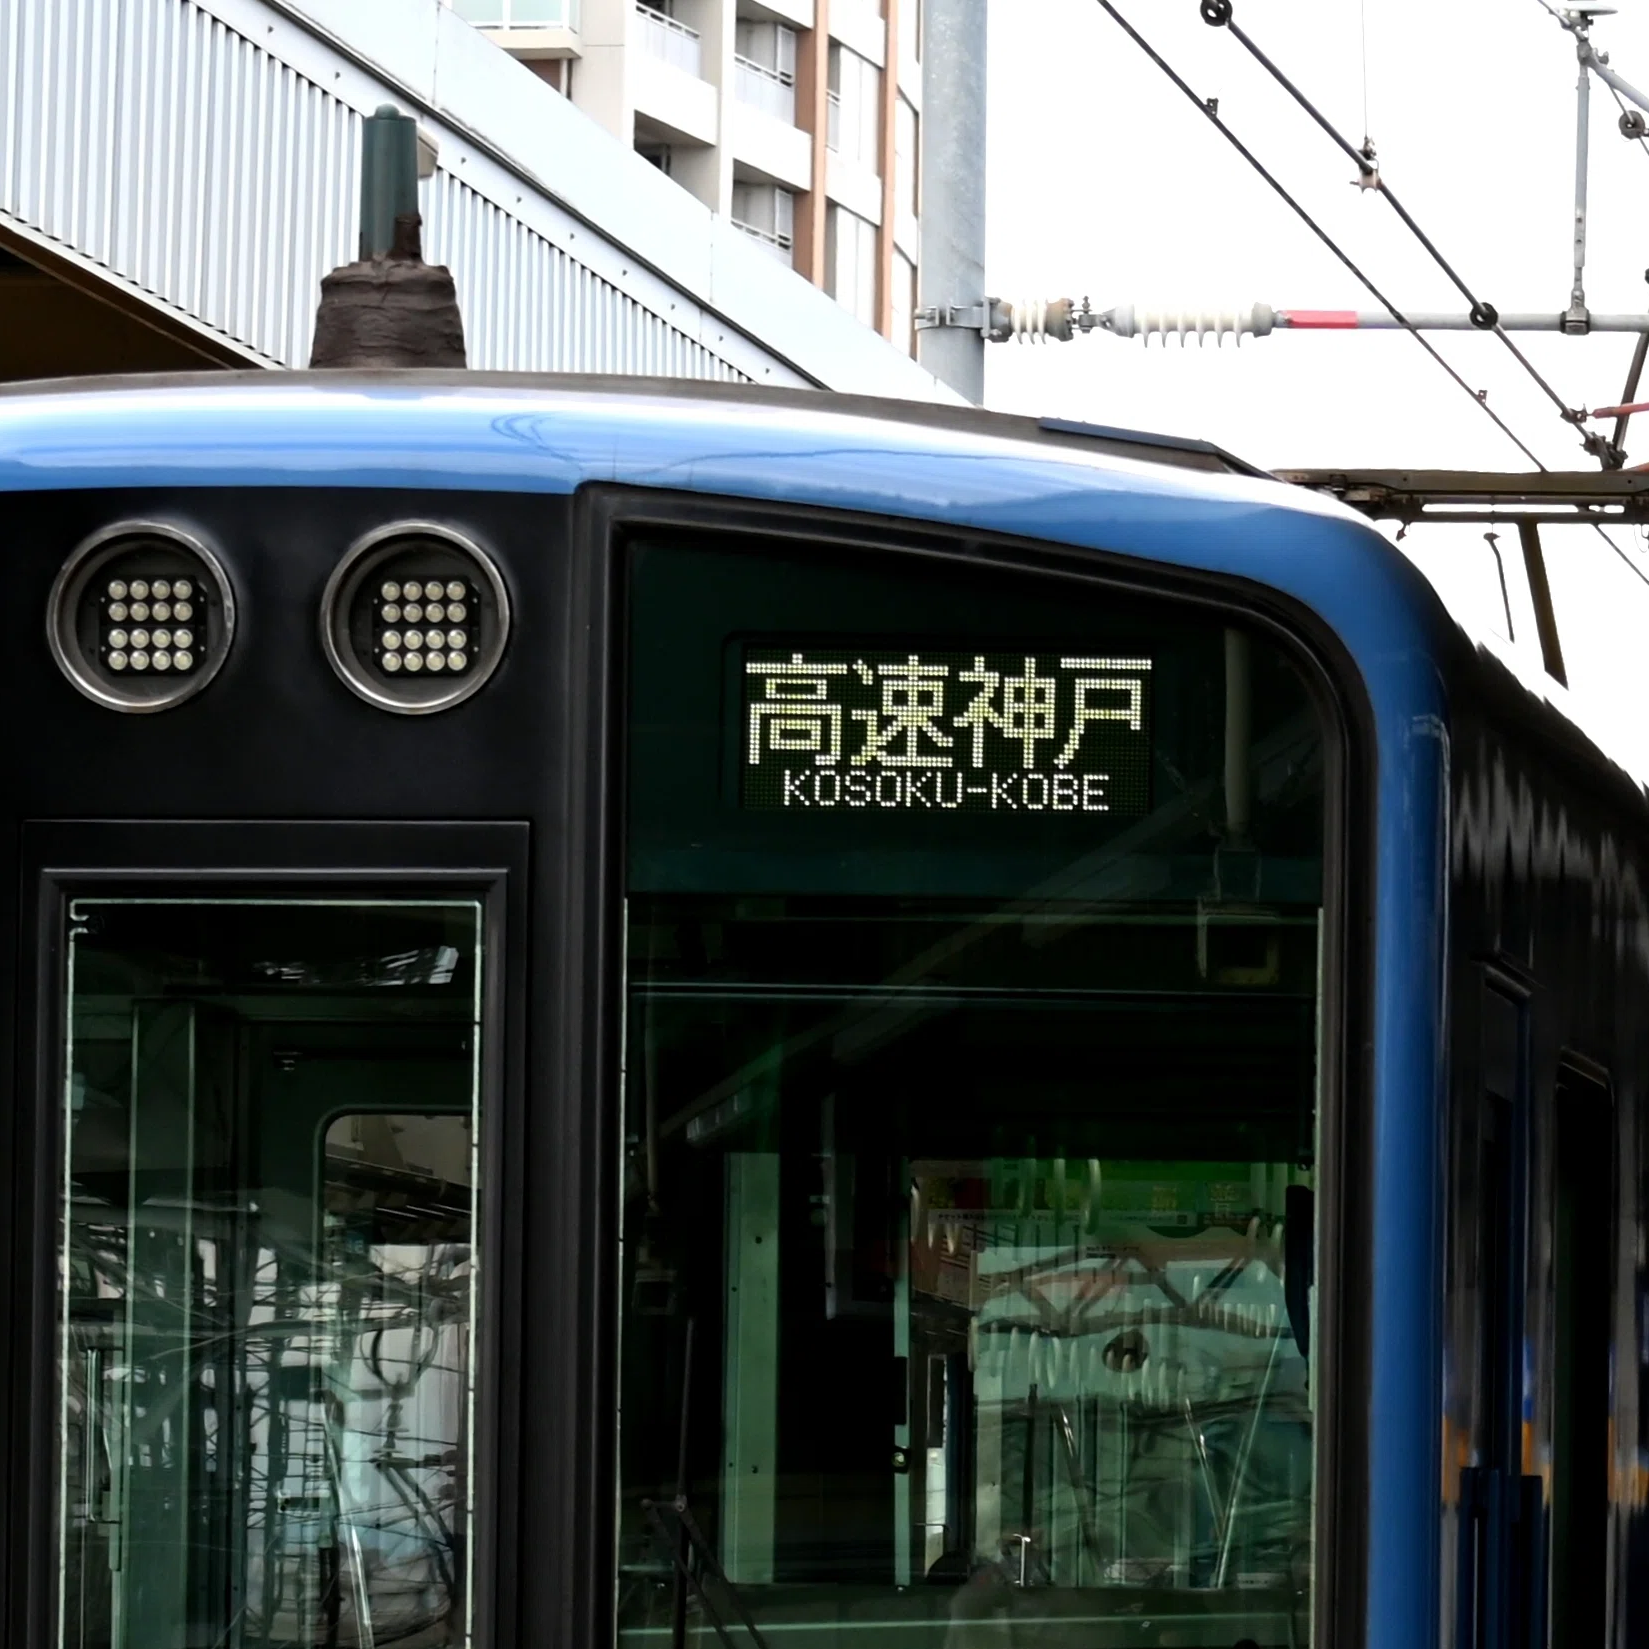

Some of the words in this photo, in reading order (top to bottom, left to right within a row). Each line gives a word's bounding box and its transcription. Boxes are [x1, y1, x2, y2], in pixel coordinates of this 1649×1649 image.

[745, 653, 1153, 770] 高速神戸
[782, 770, 1111, 812] KOSOKU-KOBE
